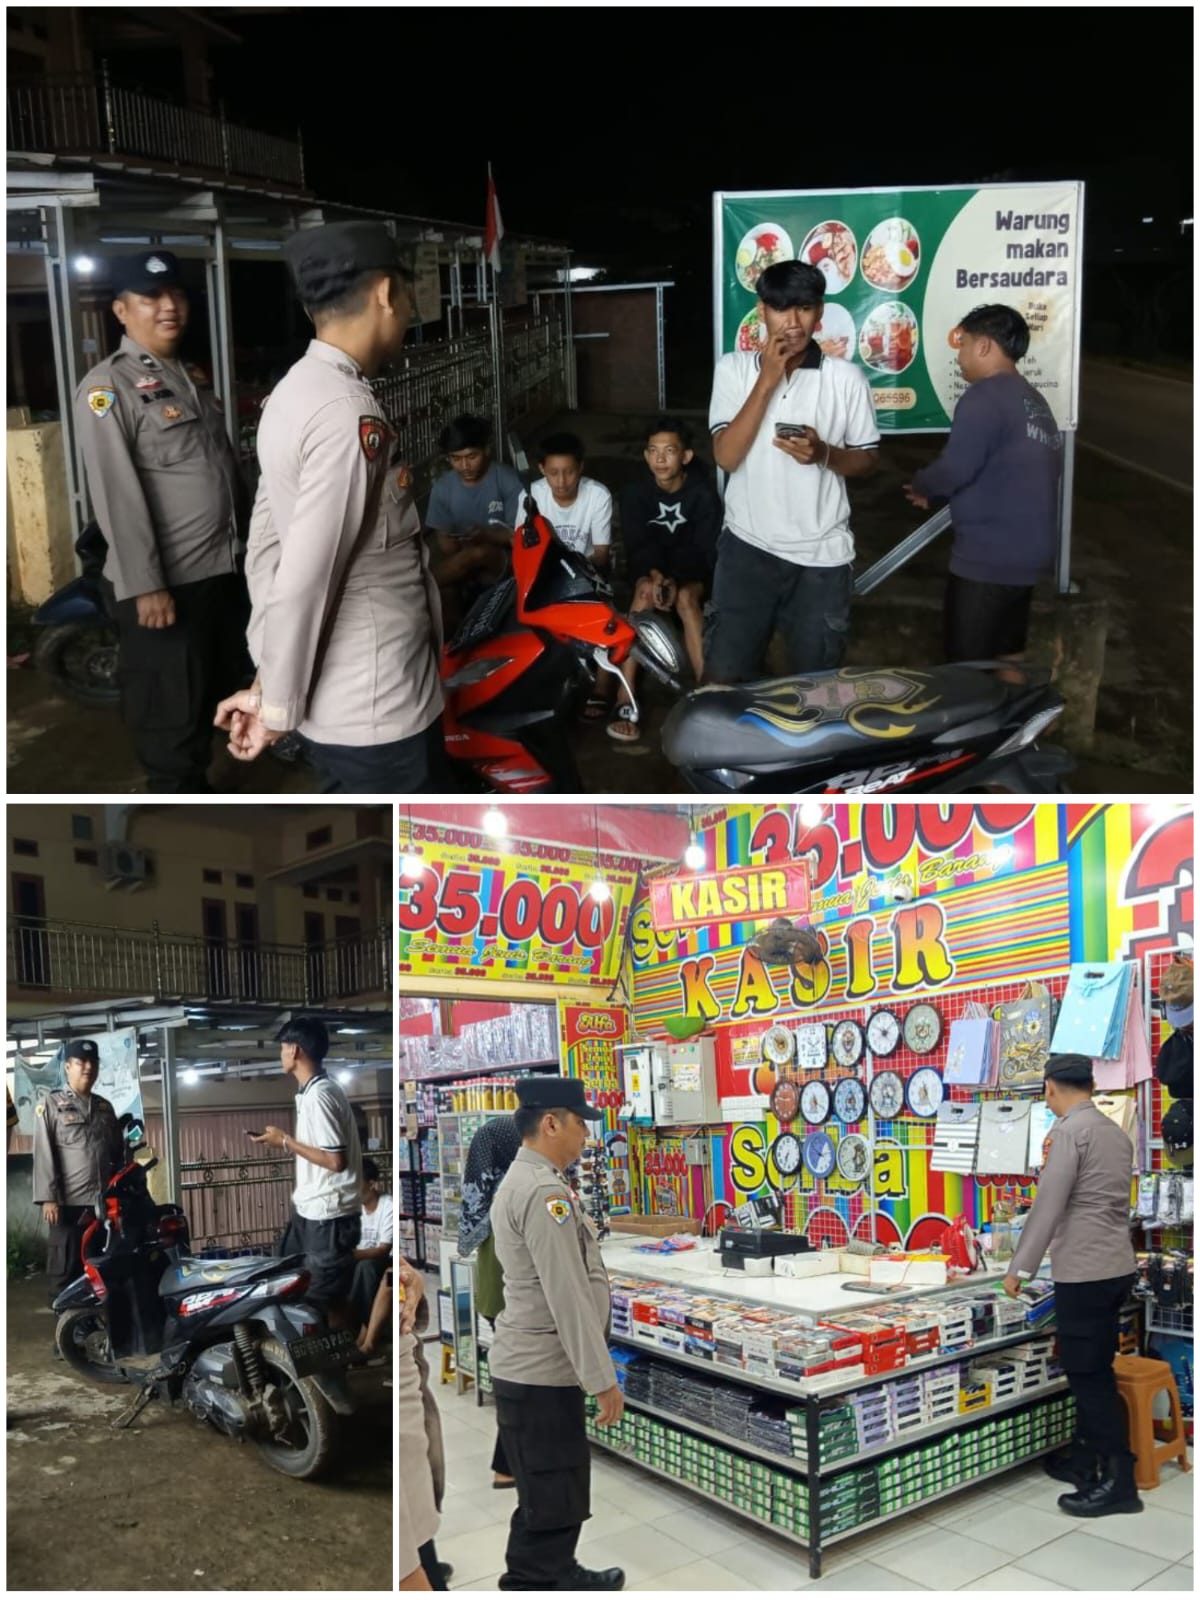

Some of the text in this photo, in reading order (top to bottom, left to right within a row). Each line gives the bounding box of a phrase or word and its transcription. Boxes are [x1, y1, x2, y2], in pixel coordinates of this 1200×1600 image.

[995, 211, 1070, 234] Warung
[1006, 240, 1069, 259] makan
[956, 269, 1068, 288] Bersaudara
[399, 864, 616, 948] 35.000
[671, 870, 788, 921] KASIR
